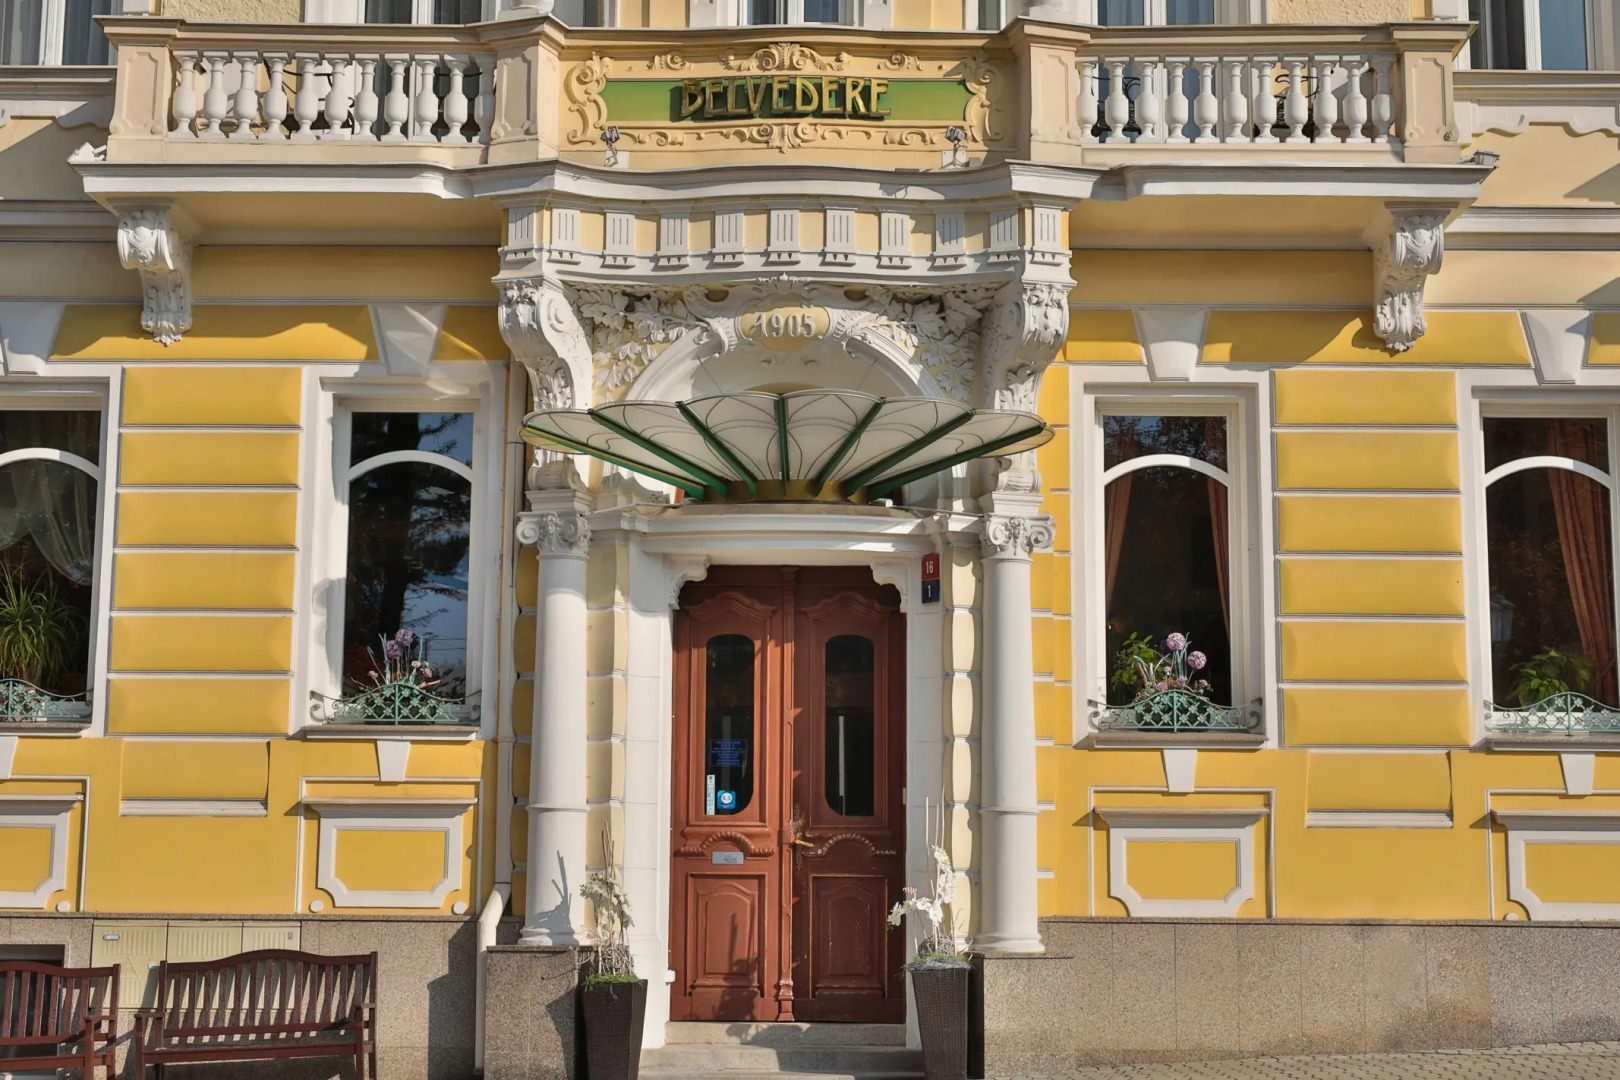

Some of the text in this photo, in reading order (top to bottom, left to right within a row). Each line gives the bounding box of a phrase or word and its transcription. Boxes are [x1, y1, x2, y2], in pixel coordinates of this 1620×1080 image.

[680, 76, 891, 118] BELVEDERE
[753, 312, 816, 338] 1905
[925, 560, 934, 574] 16
